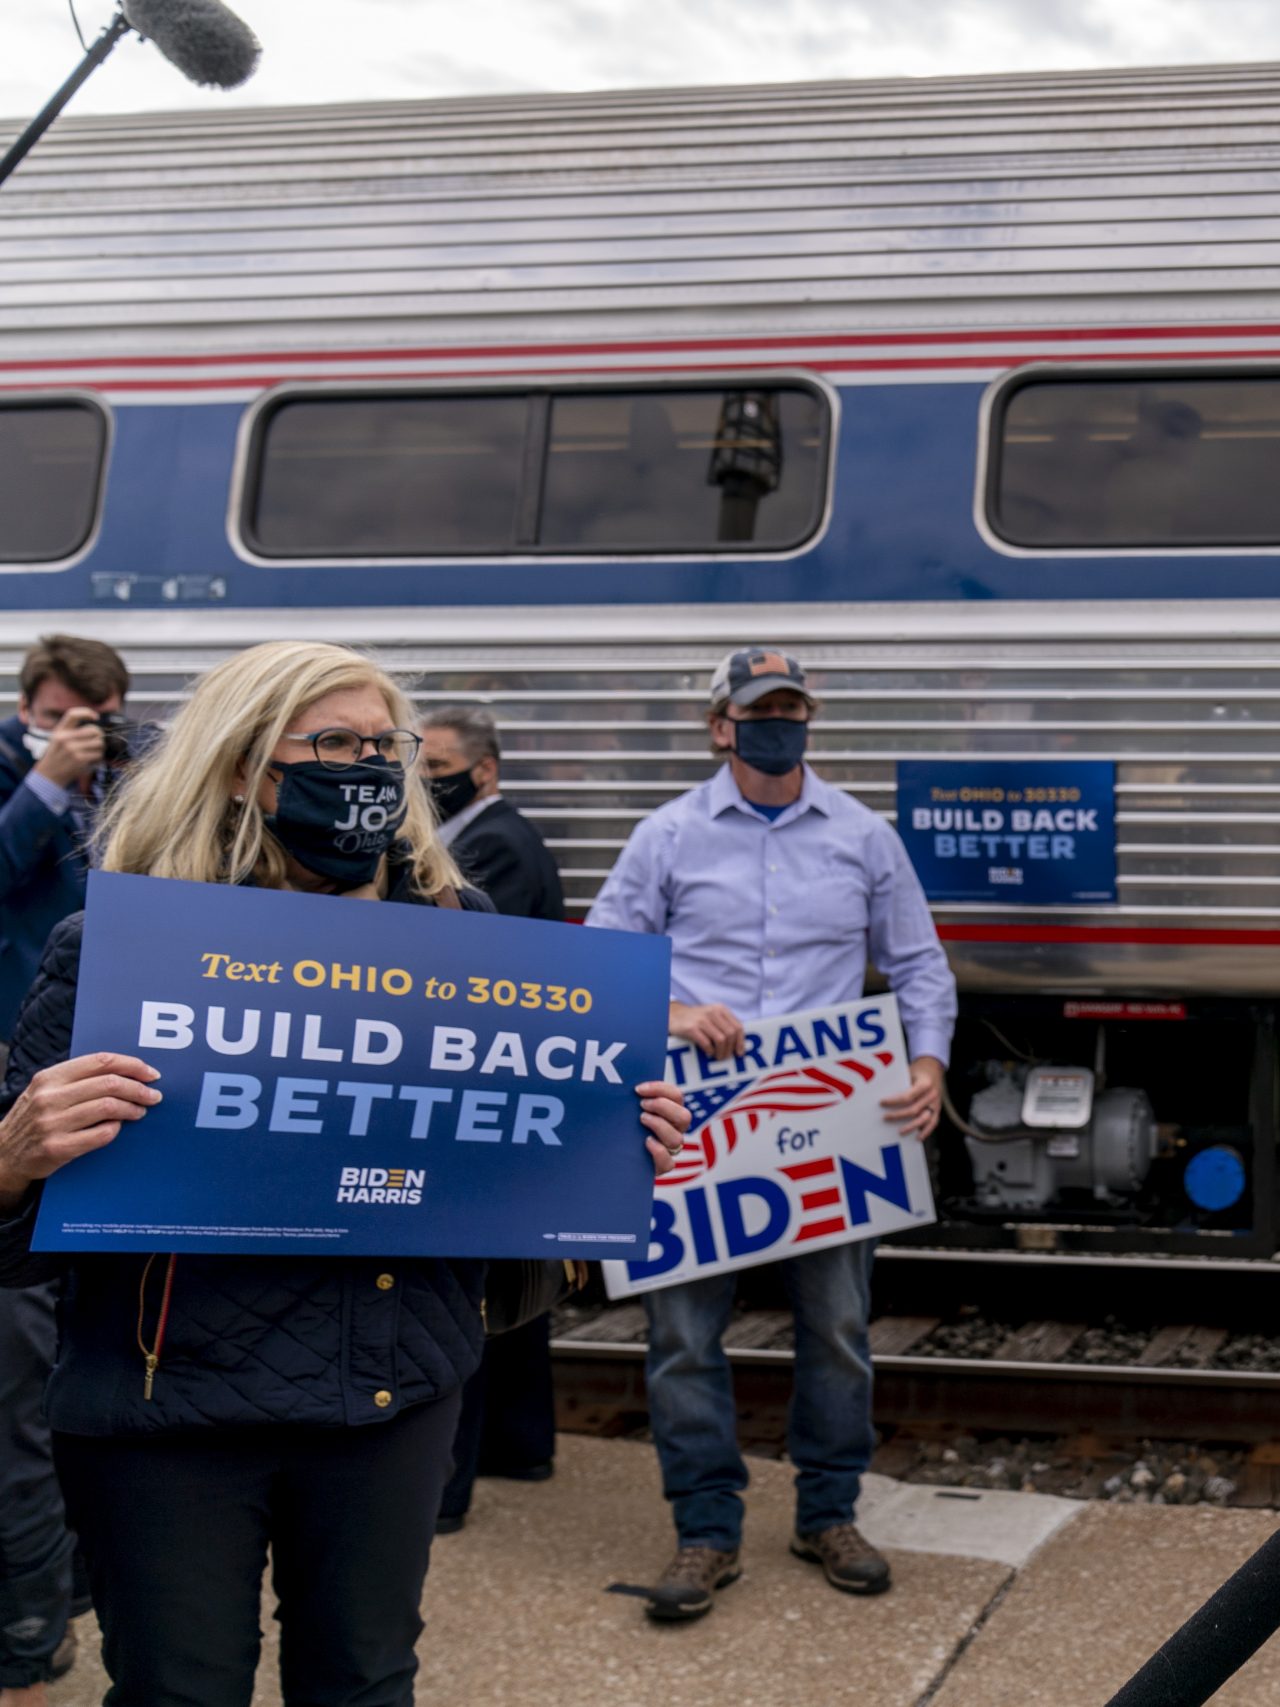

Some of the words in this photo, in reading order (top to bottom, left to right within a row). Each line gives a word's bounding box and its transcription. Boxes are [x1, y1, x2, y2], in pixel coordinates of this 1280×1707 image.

[338, 784, 398, 804] TEAM
[913, 808, 1004, 831] BUILD
[1011, 809, 1098, 831] BACK
[934, 834, 1076, 860] BETTER
[201, 952, 283, 984] Text
[293, 959, 413, 996] OHIO
[425, 977, 457, 1001] to
[466, 976, 594, 1014] 30330
[138, 1000, 404, 1066] BUILD
[429, 1025, 628, 1085] BACK
[667, 1008, 886, 1086] TERANS
[195, 1071, 566, 1147] BETTER
[776, 1127, 820, 1155] for
[340, 1167, 426, 1188] BIDEN
[336, 1186, 422, 1206] HARRIS
[626, 1143, 913, 1282] BIDEN
